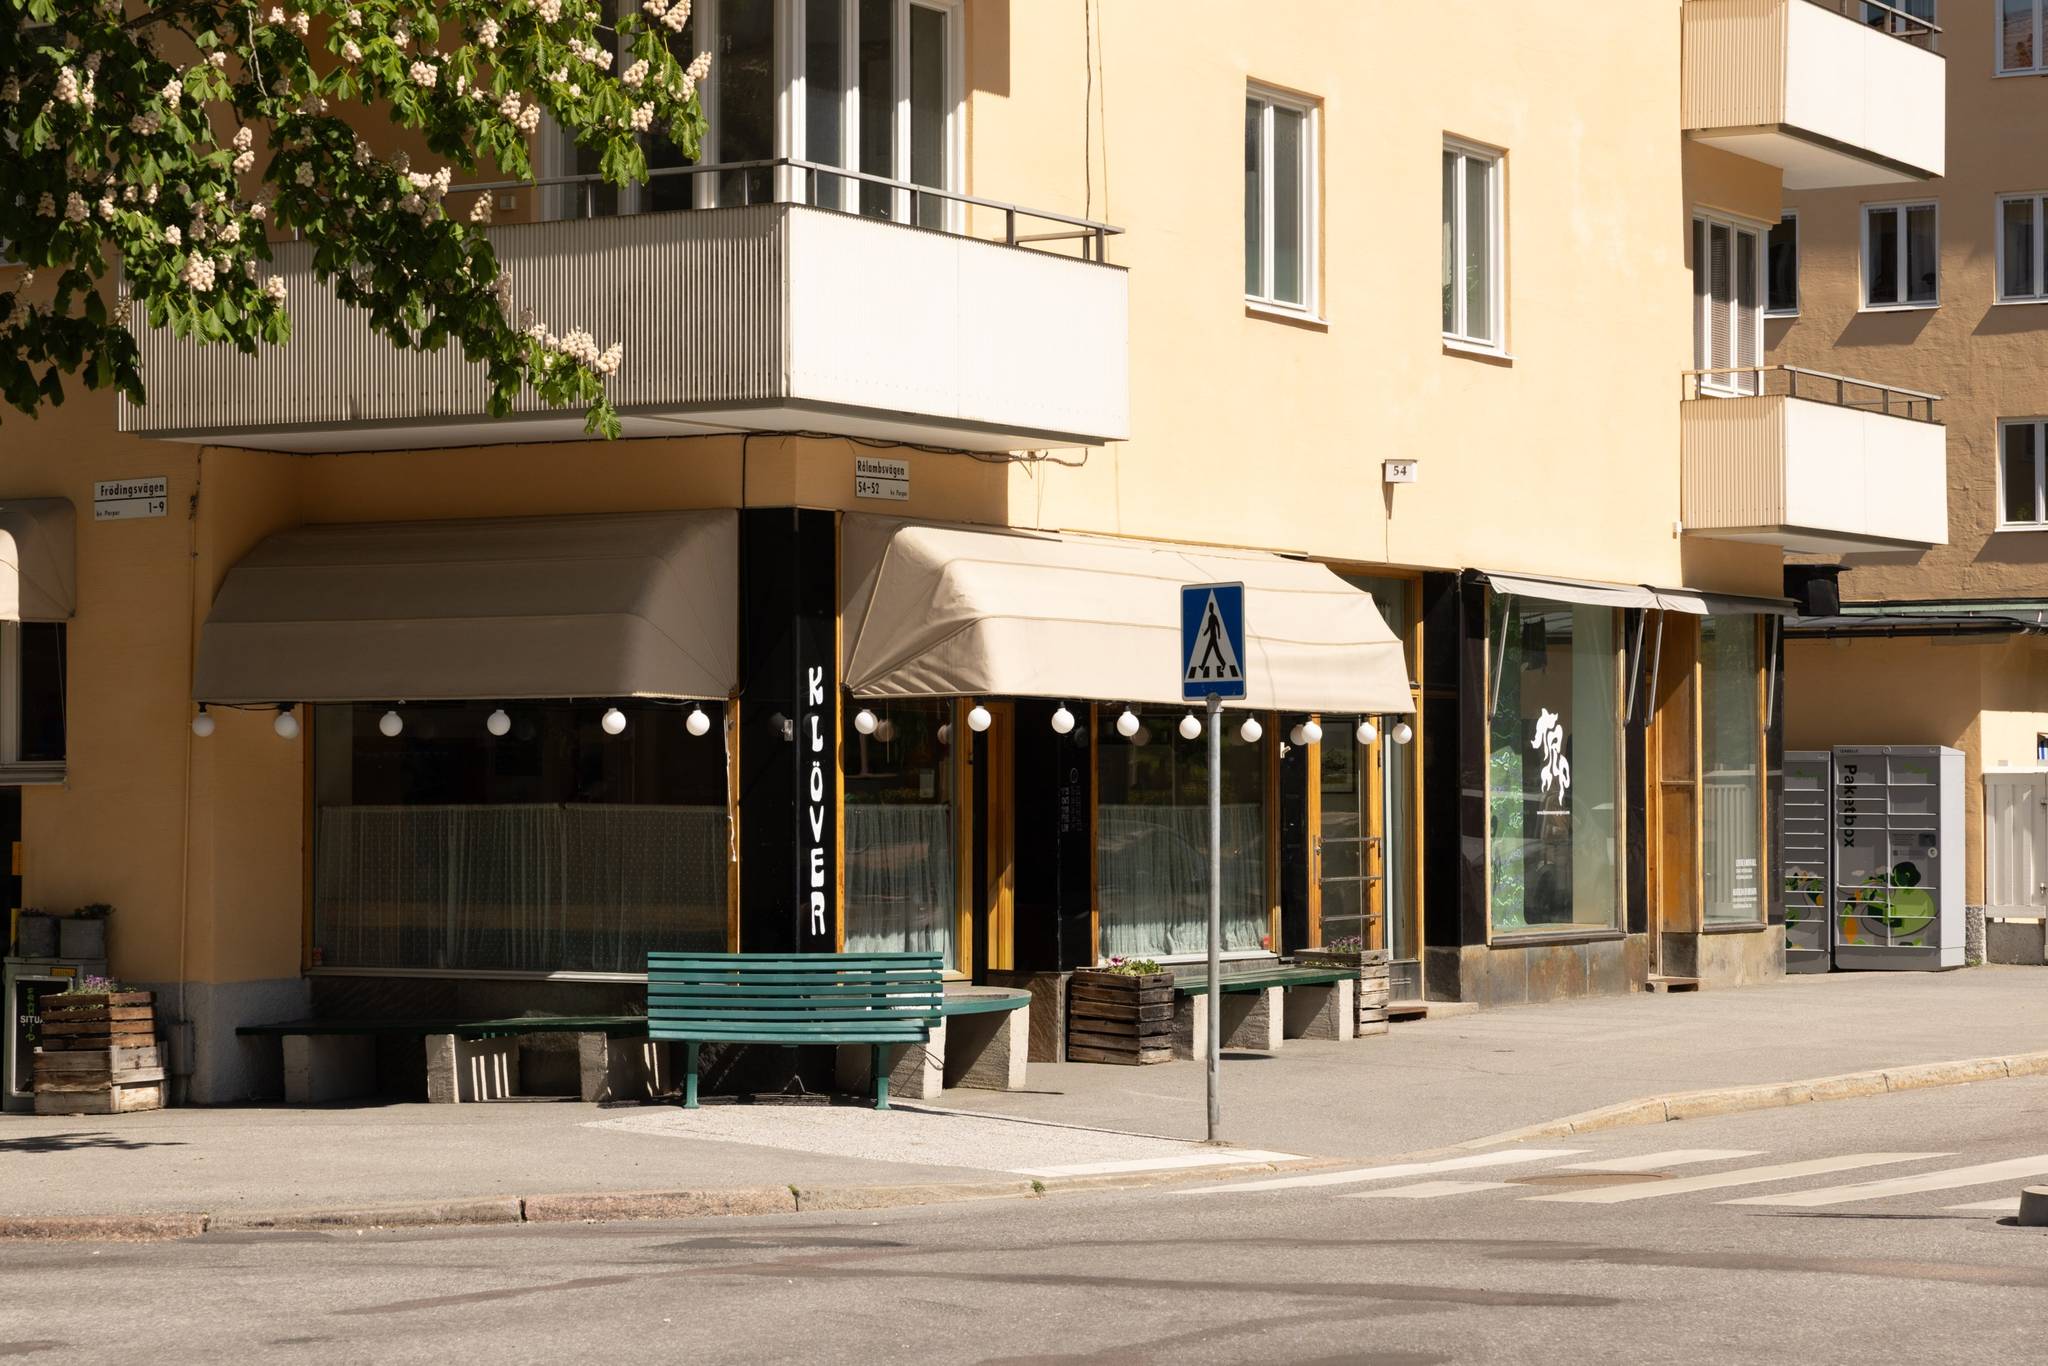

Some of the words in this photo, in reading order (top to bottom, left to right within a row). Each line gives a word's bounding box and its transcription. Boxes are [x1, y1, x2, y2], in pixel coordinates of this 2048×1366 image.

[857, 460, 905, 478] Rålambsvägen
[1393, 465, 1407, 476] 54
[101, 483, 164, 497] Frödingsvägen
[858, 481, 880, 494] 54-52
[148, 501, 164, 513] 1-9
[808, 666, 826, 936] KLÖVER
[1844, 765, 1857, 848] Paketbox
